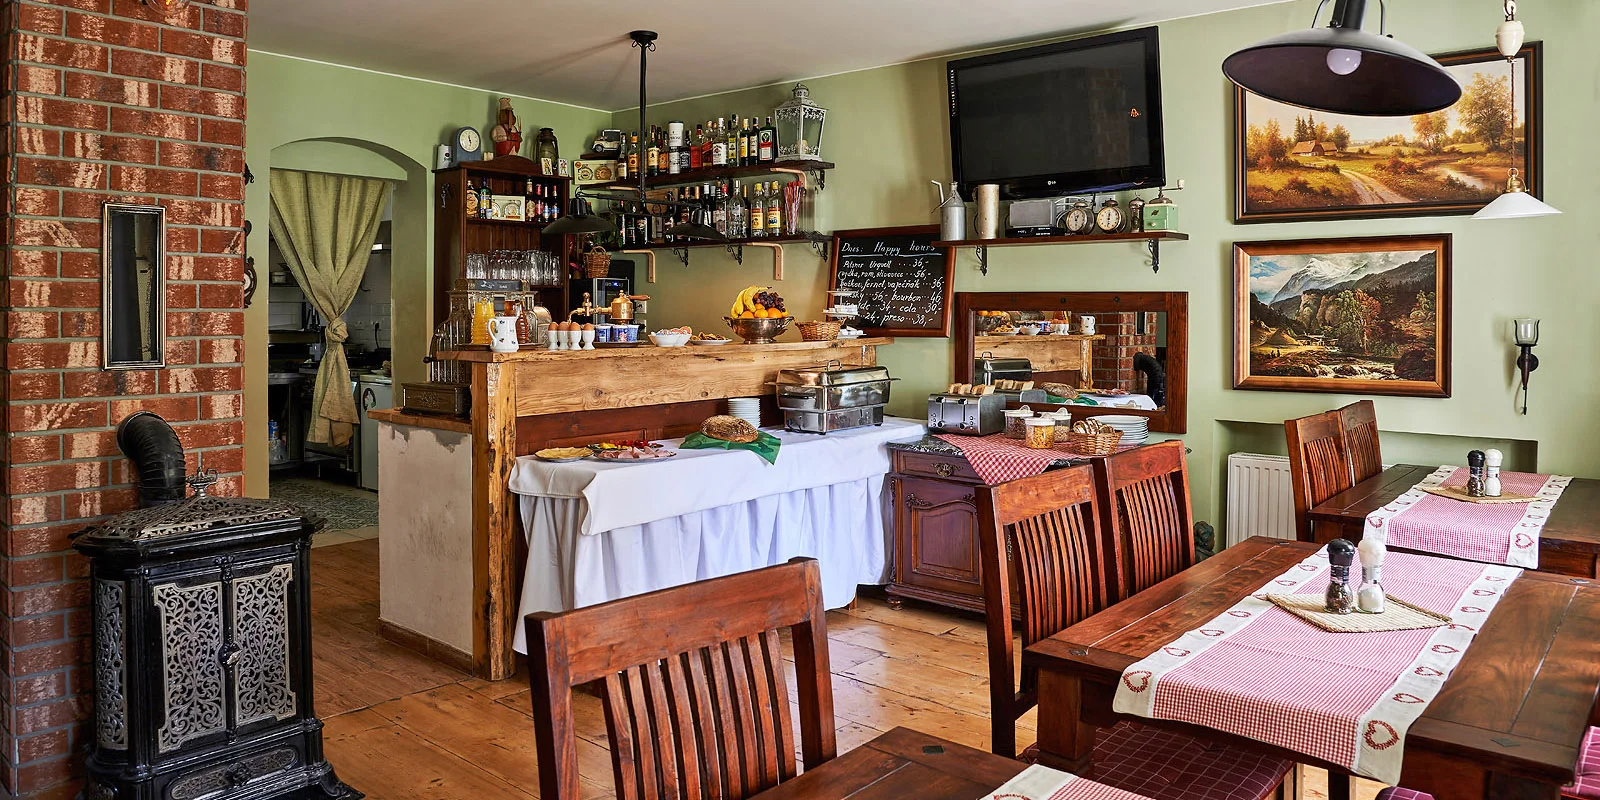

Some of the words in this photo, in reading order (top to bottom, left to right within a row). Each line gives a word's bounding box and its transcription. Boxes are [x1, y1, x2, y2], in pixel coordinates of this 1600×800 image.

[873, 241, 900, 256] Happy
[909, 240, 936, 251] hours
[843, 260, 864, 268] Pilsner
[869, 260, 892, 270] Urquell
[891, 291, 921, 302] bourbon
[899, 302, 917, 313] cola
[880, 314, 905, 327] preso
